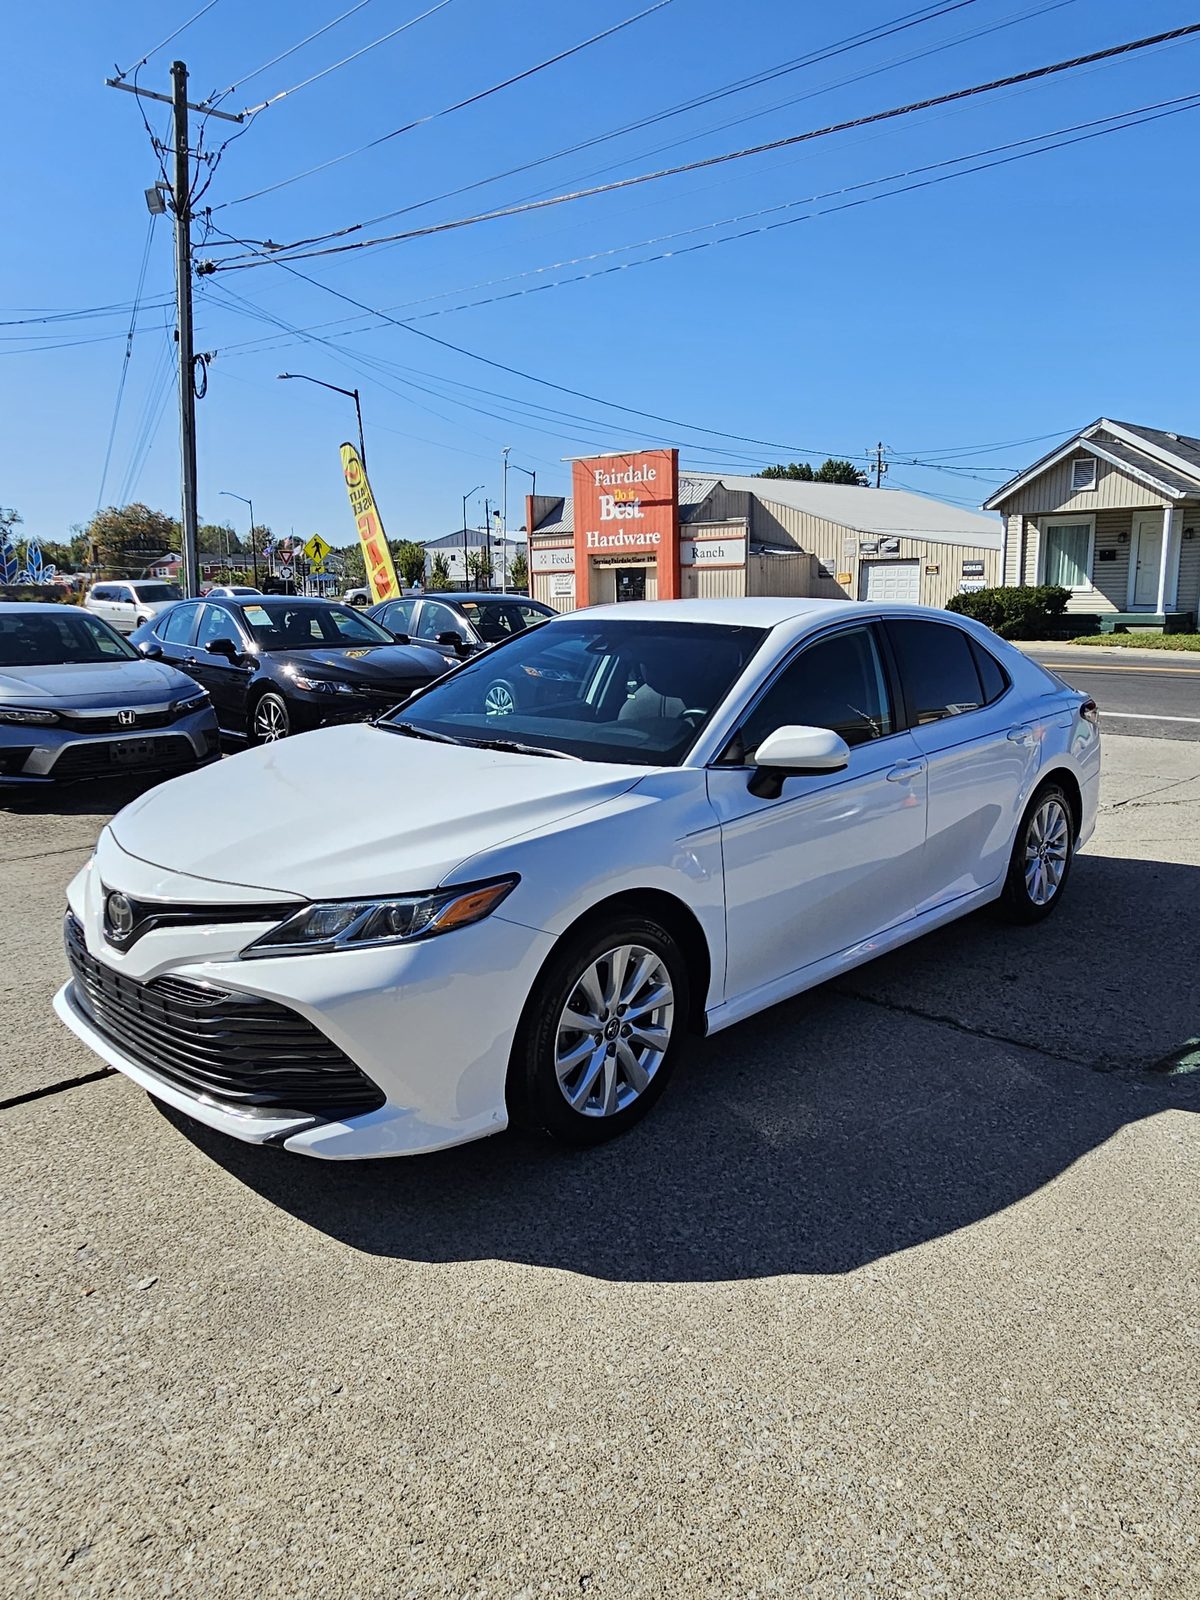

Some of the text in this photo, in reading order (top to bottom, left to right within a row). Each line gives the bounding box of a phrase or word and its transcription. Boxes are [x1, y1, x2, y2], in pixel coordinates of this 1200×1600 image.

[593, 464, 656, 486] Fairdale
[614, 487, 635, 500] Do it
[585, 528, 661, 548] Hardware
[551, 553, 574, 564] Feeds
[691, 546, 725, 559] Ranch
